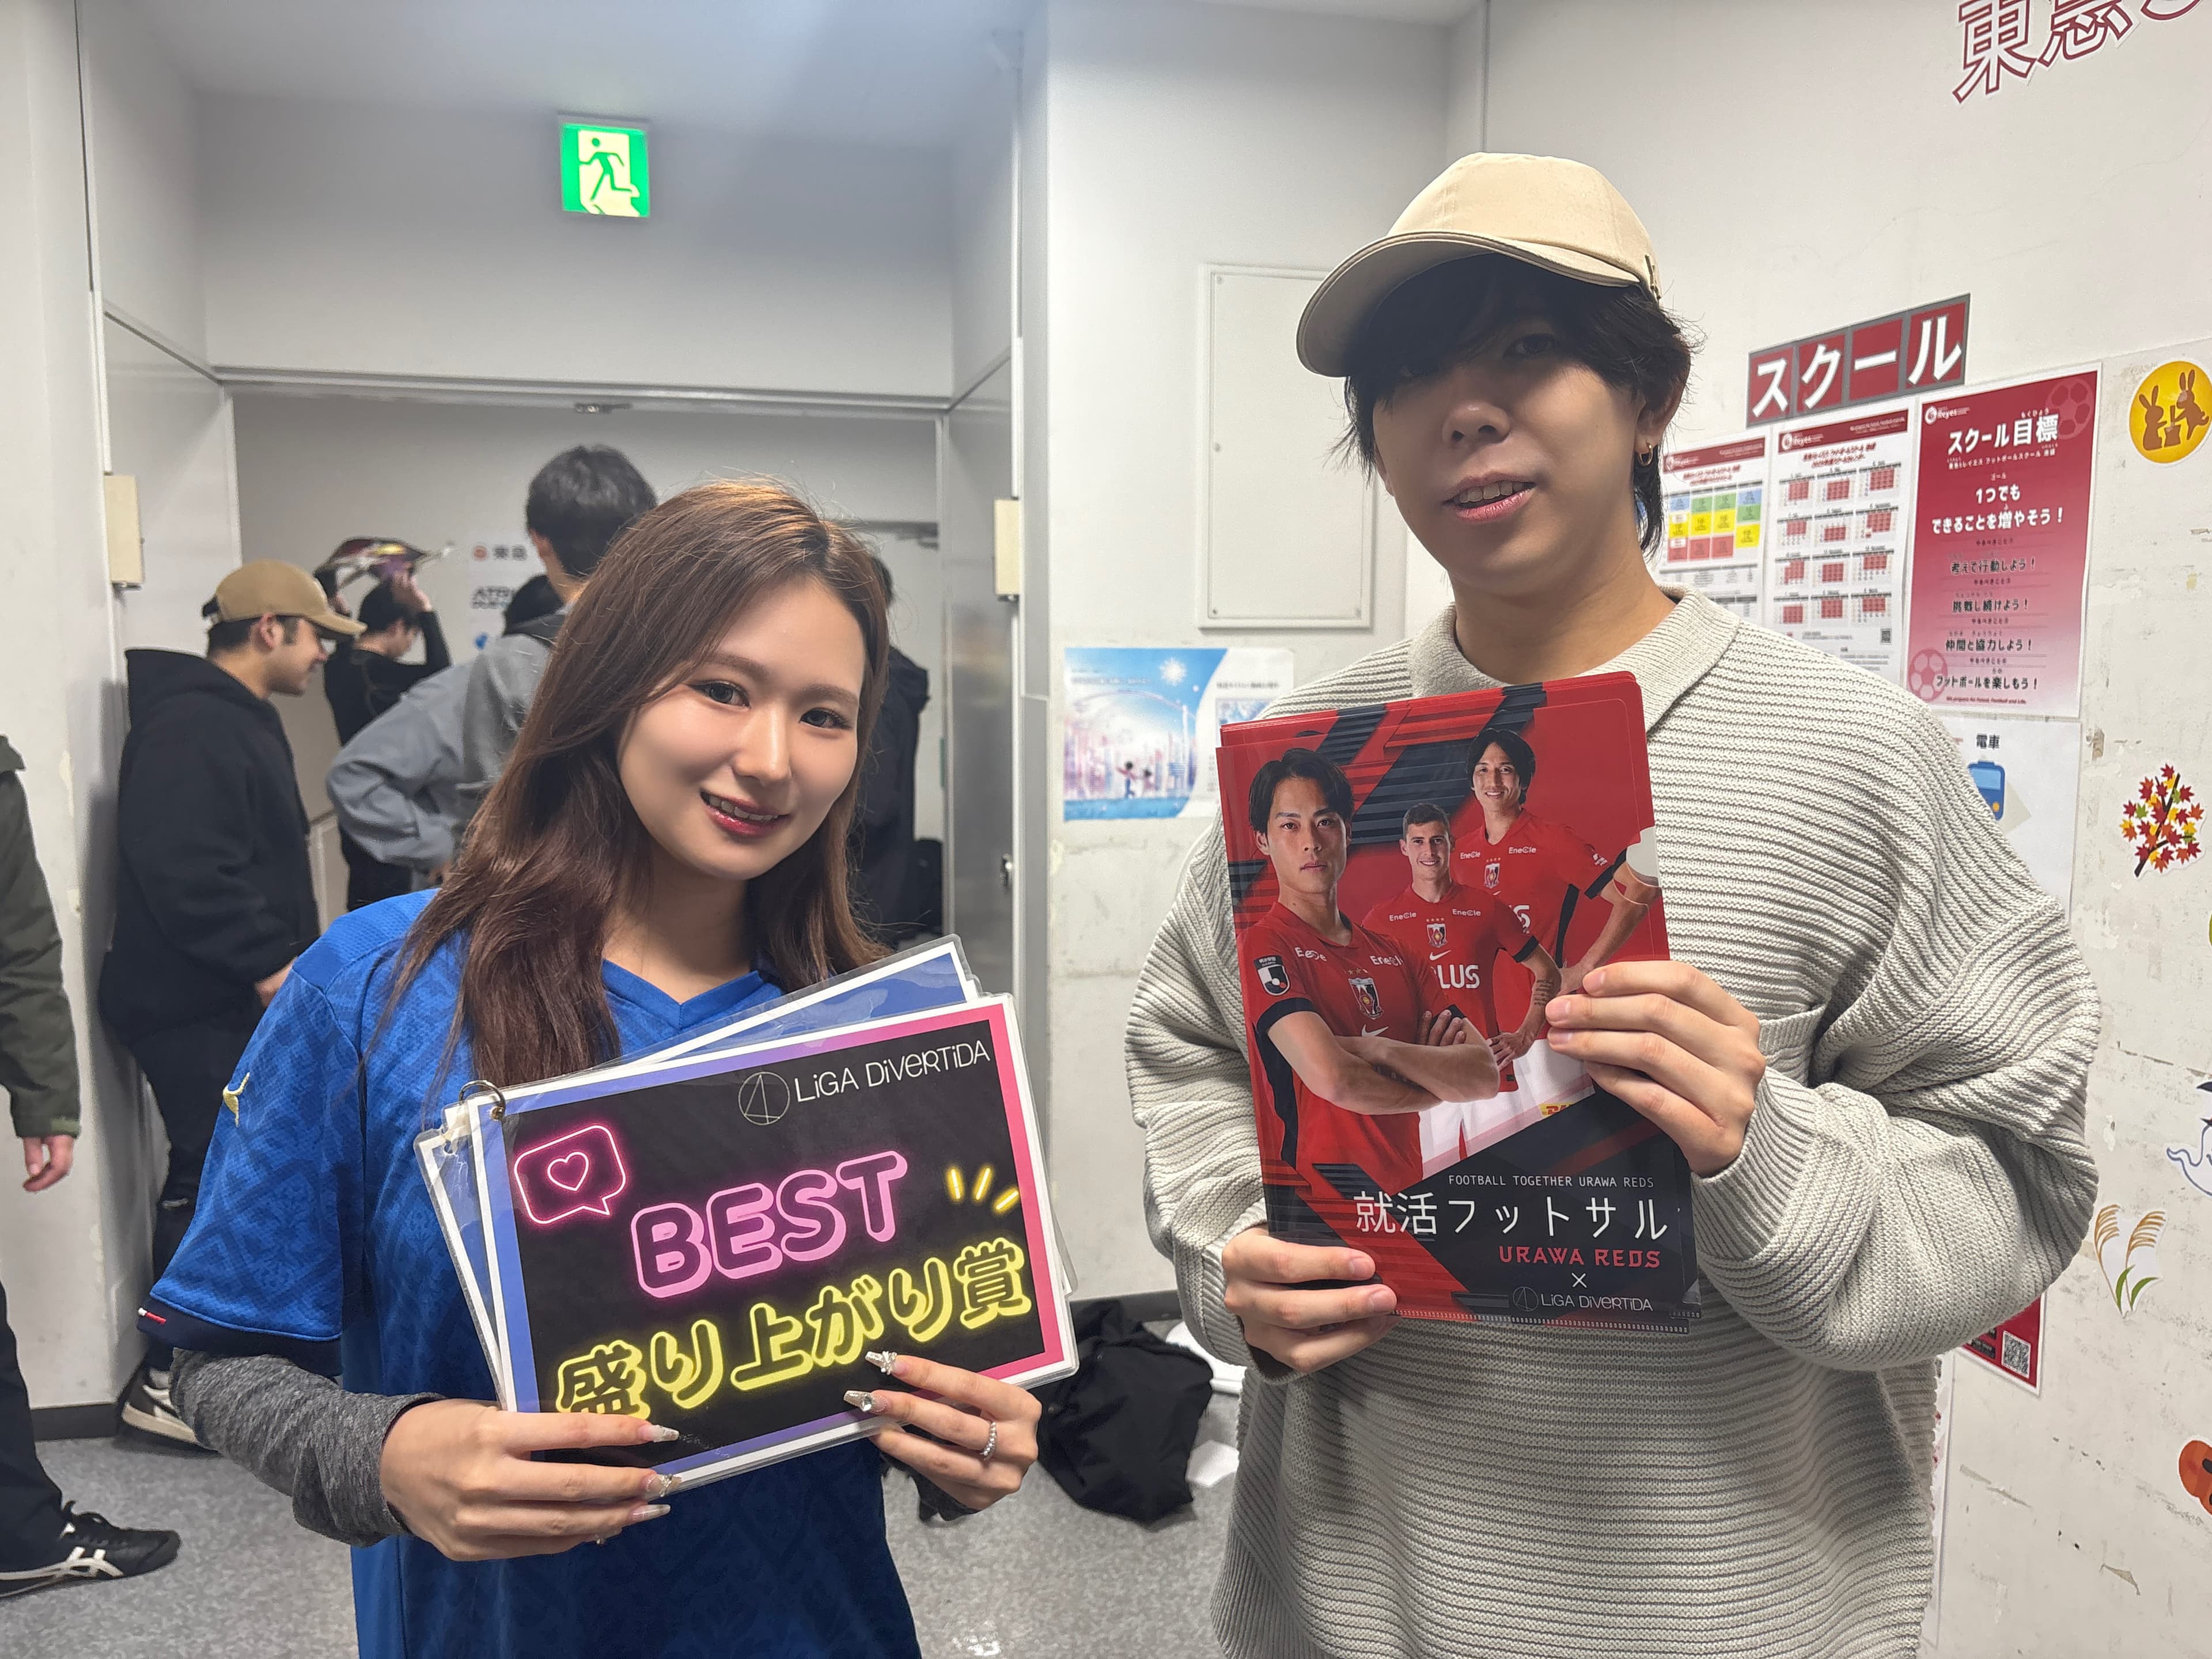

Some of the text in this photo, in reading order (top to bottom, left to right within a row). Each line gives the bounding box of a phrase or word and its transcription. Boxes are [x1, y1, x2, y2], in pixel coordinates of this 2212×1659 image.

[1753, 315, 1961, 418] スクール
[1948, 414, 2059, 455] スクール目標
[1976, 484, 2021, 504] 1つでも
[1976, 733, 2000, 750] 電車
[1431, 964, 1480, 989] LUS
[1448, 1175, 1654, 1188] FOOTBALL TOGETHER URAWA REDS
[631, 1150, 907, 1298] BEST
[1354, 1191, 1668, 1240] 就活フットサル
[1499, 1245, 1660, 1268] URAWA REDS
[556, 1238, 1031, 1422] 盛り上がり賞
